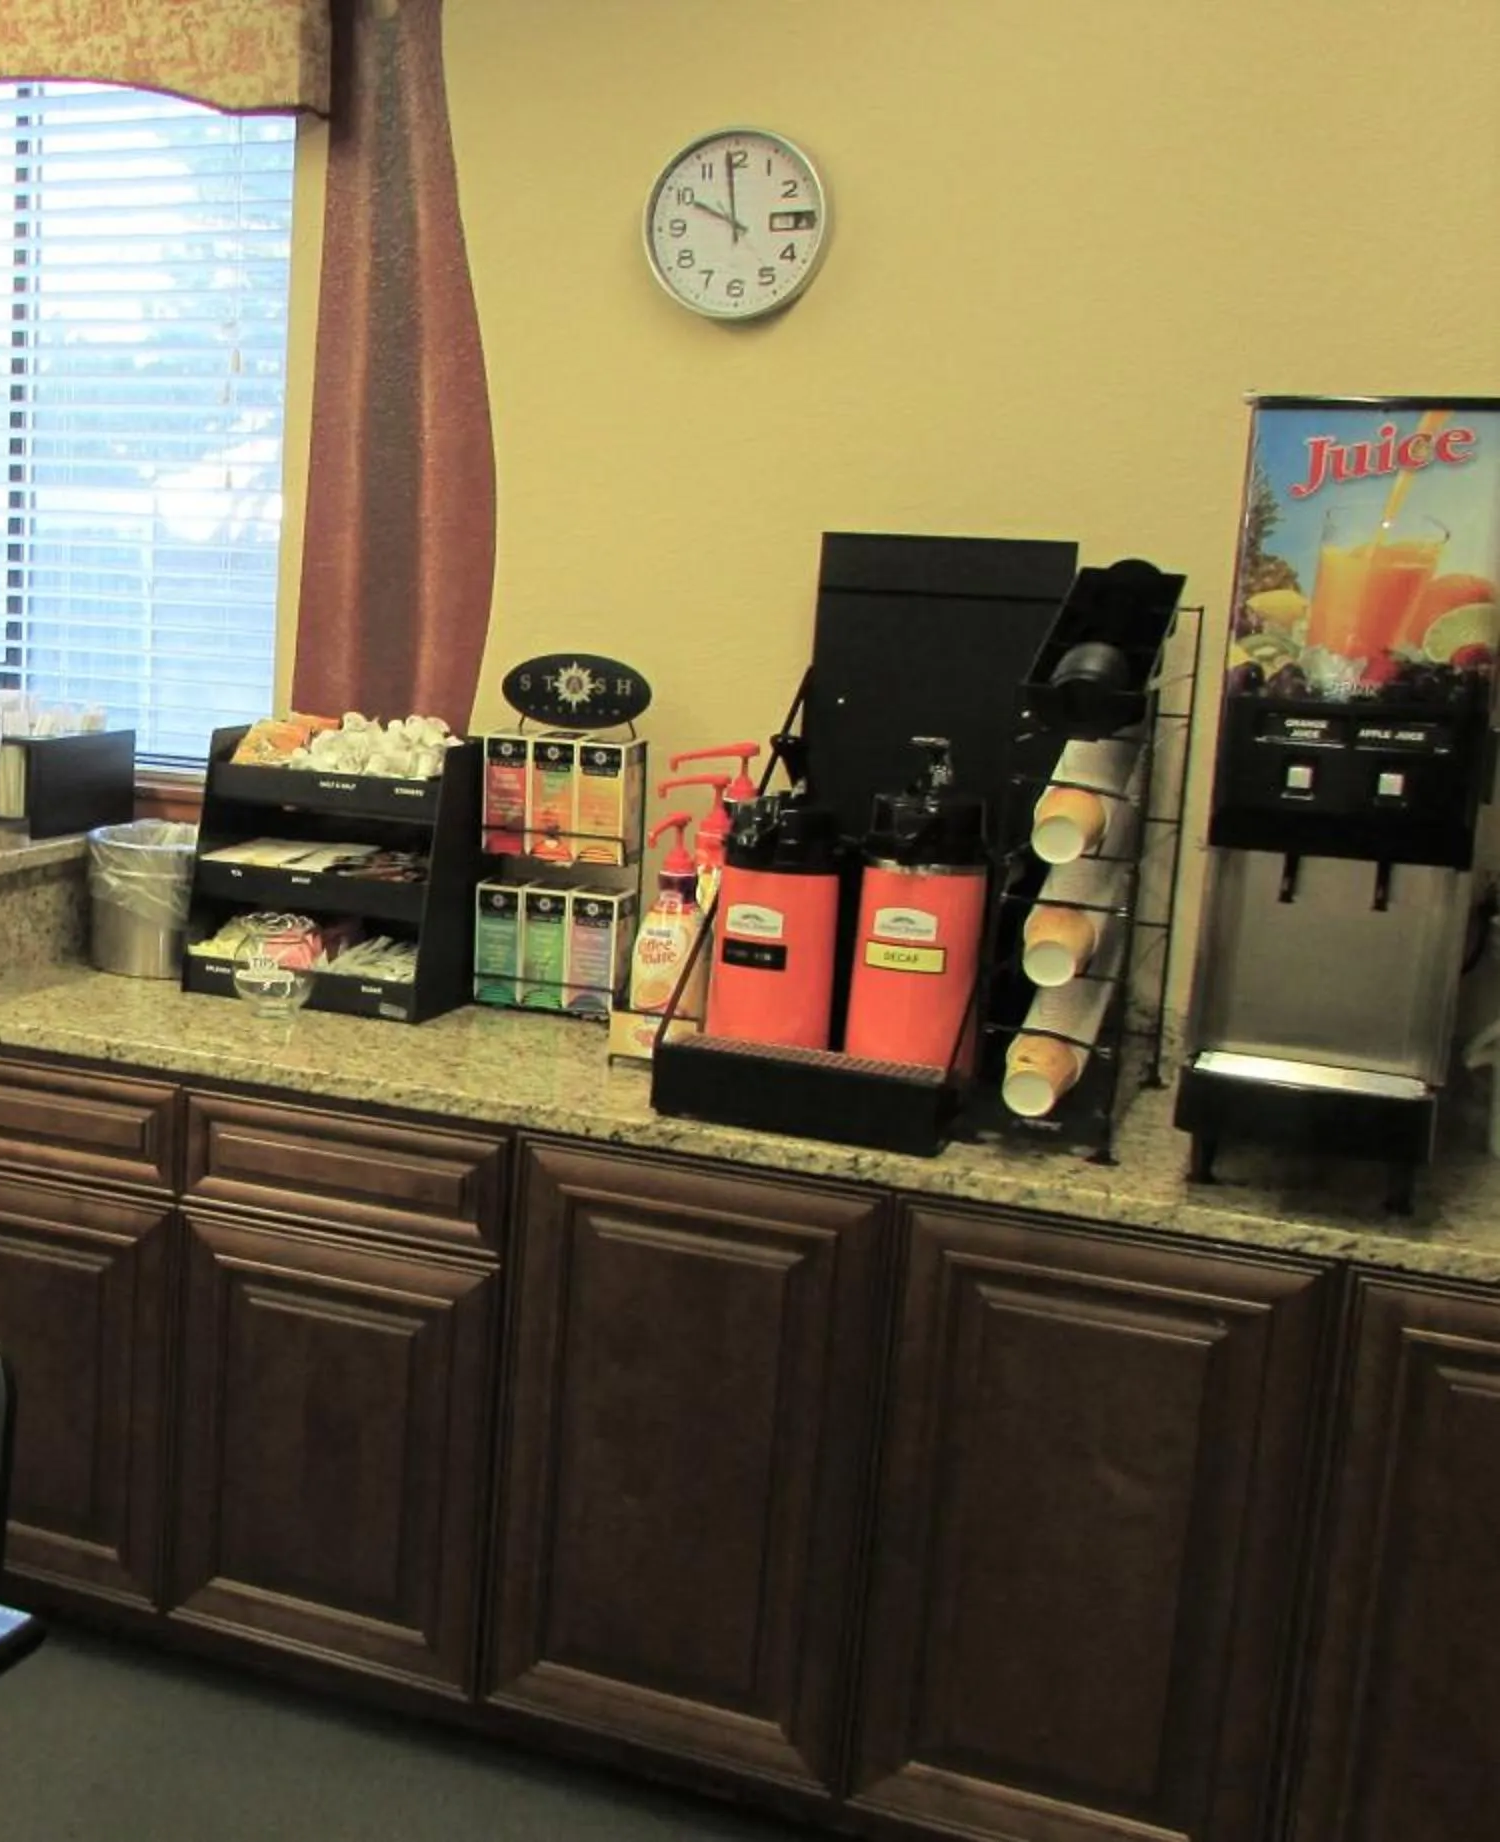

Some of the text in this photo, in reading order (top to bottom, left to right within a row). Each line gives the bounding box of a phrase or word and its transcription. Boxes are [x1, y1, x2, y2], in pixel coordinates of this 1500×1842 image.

[726, 152, 748, 169] 2
[701, 162, 713, 181] 11
[676, 186, 695, 205] 10
[781, 179, 798, 199] 2
[669, 218, 687, 238] 9
[677, 249, 695, 269] 8
[779, 242, 796, 262] 4
[701, 269, 714, 289] 7
[757, 266, 776, 285] 5
[726, 279, 744, 298] 6
[1289, 422, 1476, 499] Juice
[518, 673, 633, 697] STASH
[1358, 729, 1392, 739] APPLE
[252, 957, 275, 970] TIPS
[883, 950, 918, 964] DECAF
